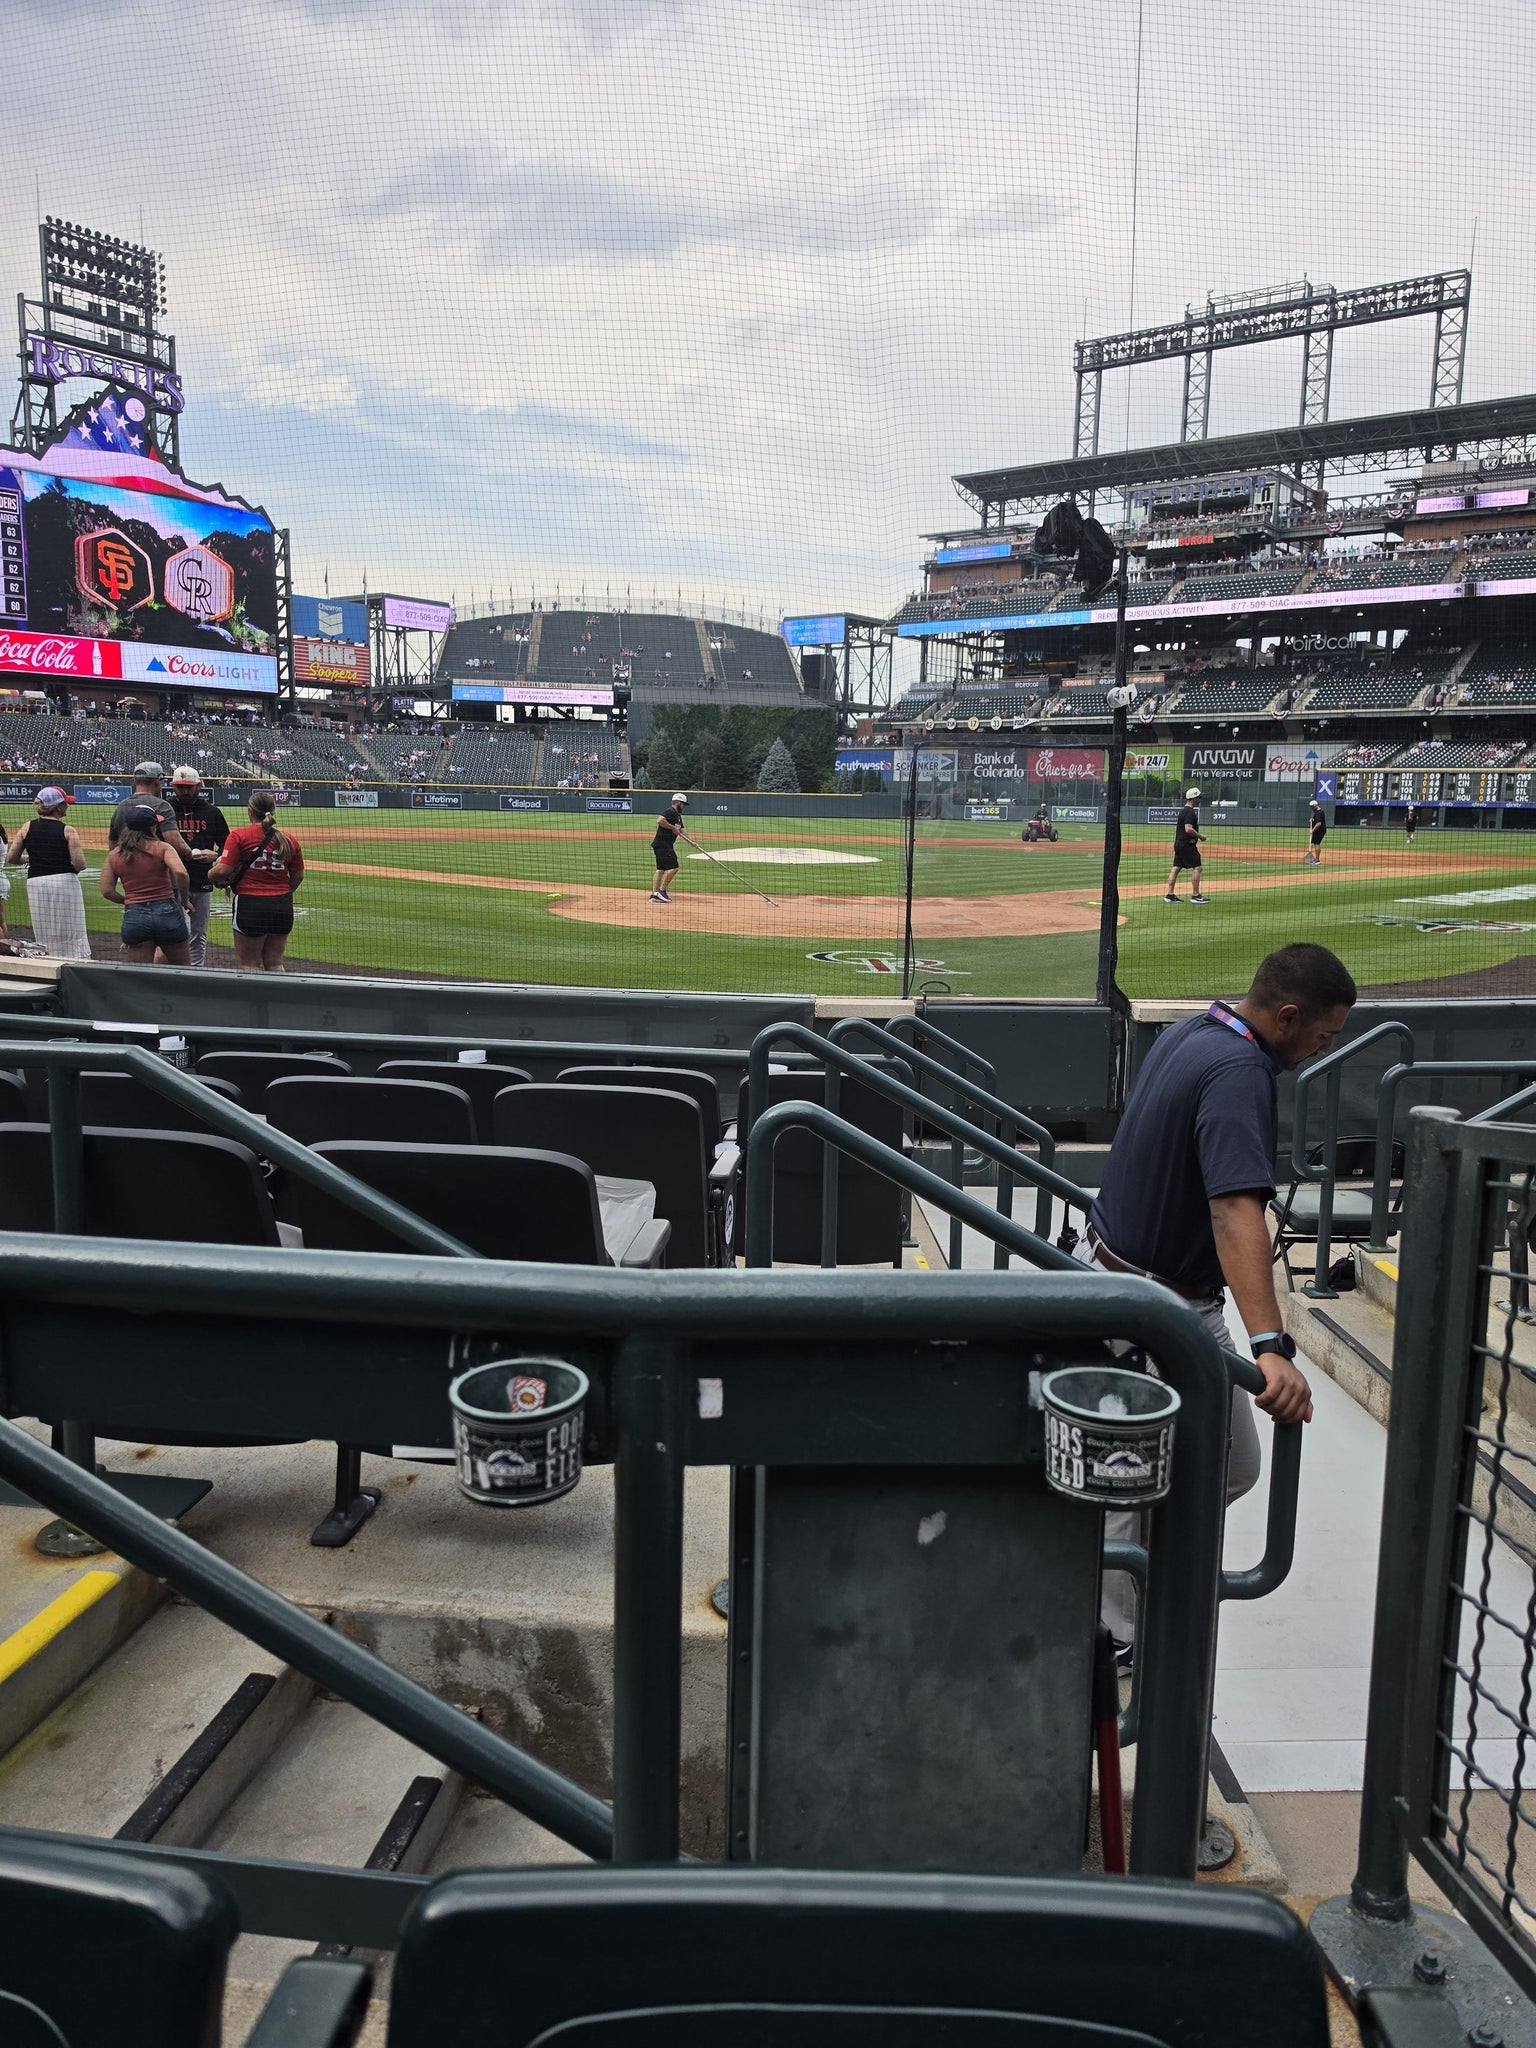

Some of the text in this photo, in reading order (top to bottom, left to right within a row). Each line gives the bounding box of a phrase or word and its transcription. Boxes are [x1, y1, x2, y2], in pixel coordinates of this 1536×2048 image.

[27, 336, 186, 412] ROCKIES
[1502, 454, 1527, 465] JACK
[7, 527, 16, 537] 63
[1147, 534, 1214, 550] SMASHBURGER
[8, 545, 17, 556] 62
[9, 564, 19, 575] 62
[97, 539, 135, 600] SF
[10, 583, 20, 593] 62
[177, 558, 216, 616] CR
[11, 601, 20, 611] 60
[317, 602, 343, 613] Chevron
[1230, 599, 1290, 611] 877-509-CIAC
[1127, 607, 1171, 619] SUSPICIOUS
[1172, 605, 1205, 615] ACTIVITY
[1293, 631, 1357, 652] birdcall
[308, 644, 357, 666] KING
[167, 655, 260, 681] Coors LIGHT
[309, 661, 358, 682] Soopers
[394, 698, 413, 706] PLATTE
[974, 751, 1015, 765] Bank of
[1147, 755, 1168, 767] 24/7
[1192, 749, 1255, 765] ARROW
[834, 760, 885, 771] Southwest
[1268, 755, 1312, 773] Coors
[973, 765, 1025, 778] Colorado
[1191, 769, 1253, 778] Five Years Out
[424, 794, 459, 804] Lifetime
[511, 799, 541, 809] dialpad
[971, 806, 1000, 815] bet365
[1069, 809, 1095, 817] DaBella
